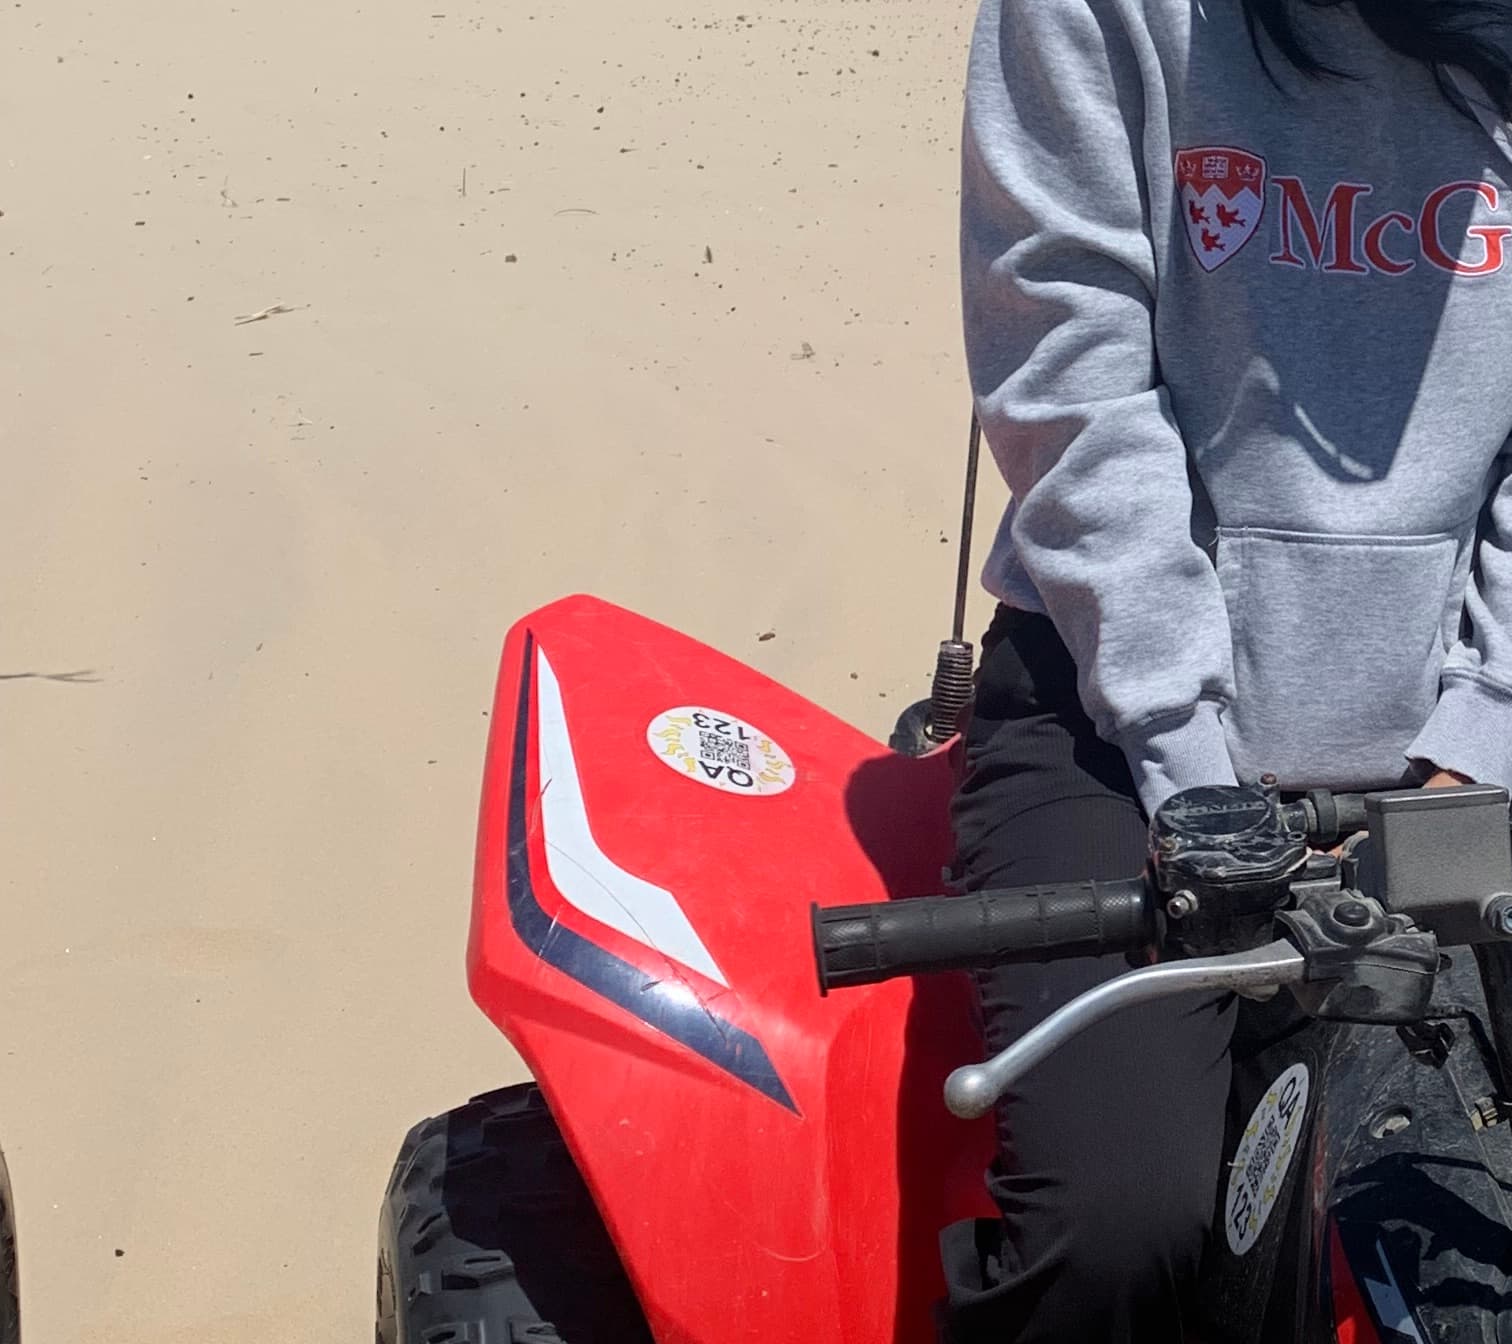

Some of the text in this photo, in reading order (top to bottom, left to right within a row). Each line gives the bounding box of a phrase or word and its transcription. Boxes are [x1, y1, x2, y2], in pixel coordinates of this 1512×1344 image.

[692, 712, 751, 740] 123
[698, 760, 754, 788] QA
[1279, 1076, 1301, 1131] QA
[1231, 1182, 1252, 1241] 123
